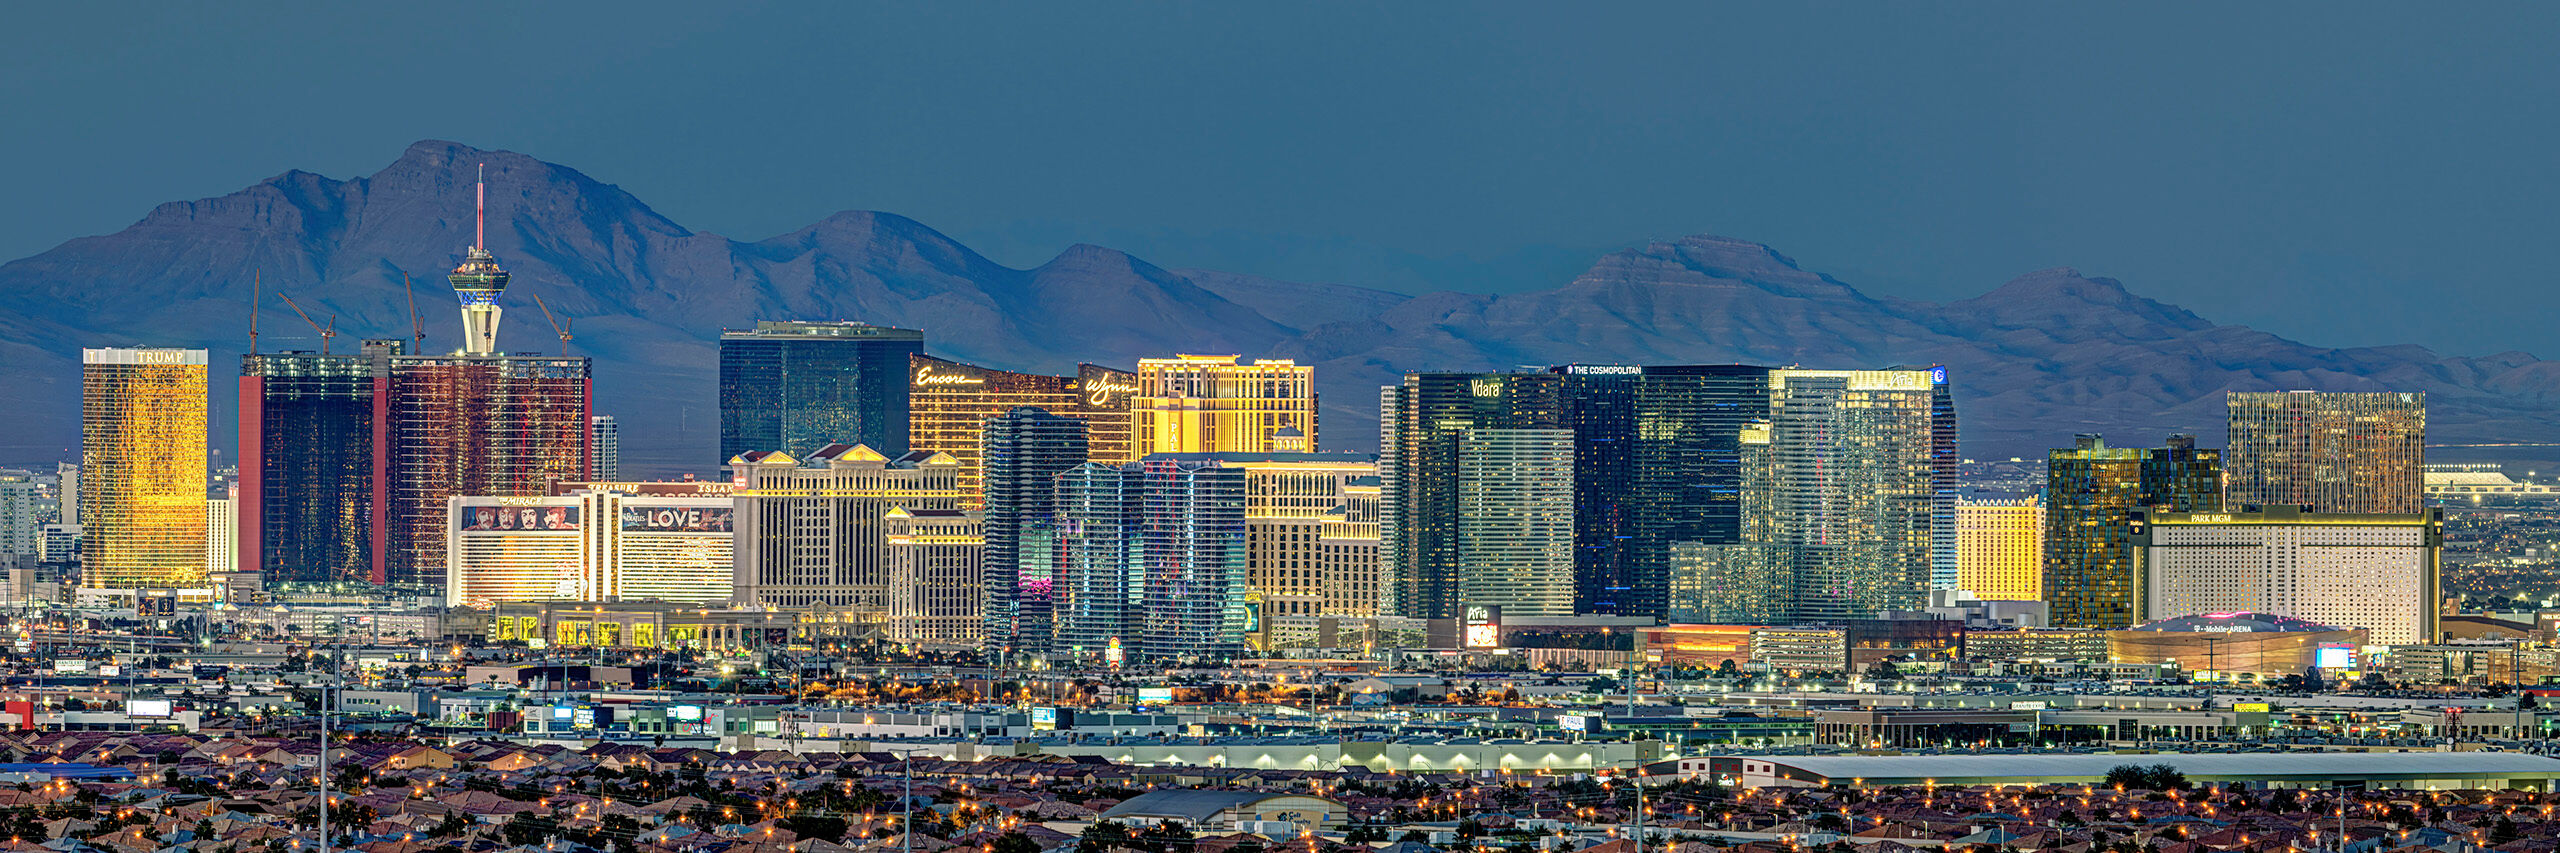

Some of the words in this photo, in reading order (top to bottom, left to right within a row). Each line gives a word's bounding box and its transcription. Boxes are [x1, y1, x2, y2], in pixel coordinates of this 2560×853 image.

[137, 351, 183, 363] TRUMP
[917, 366, 984, 386] Encore
[1575, 366, 1588, 375] THE
[1589, 366, 1642, 375] COSMOPOLITAN
[1891, 372, 1913, 386] Aria
[1085, 372, 1140, 406] Wynn
[1471, 379, 1500, 397] Vdara
[588, 484, 639, 494] TREASURE
[507, 497, 542, 506] MIRAGE
[648, 510, 700, 528] LOVE
[2191, 514, 2210, 523] PARK
[2212, 514, 2231, 523] MGM
[1467, 606, 1488, 620] Aria
